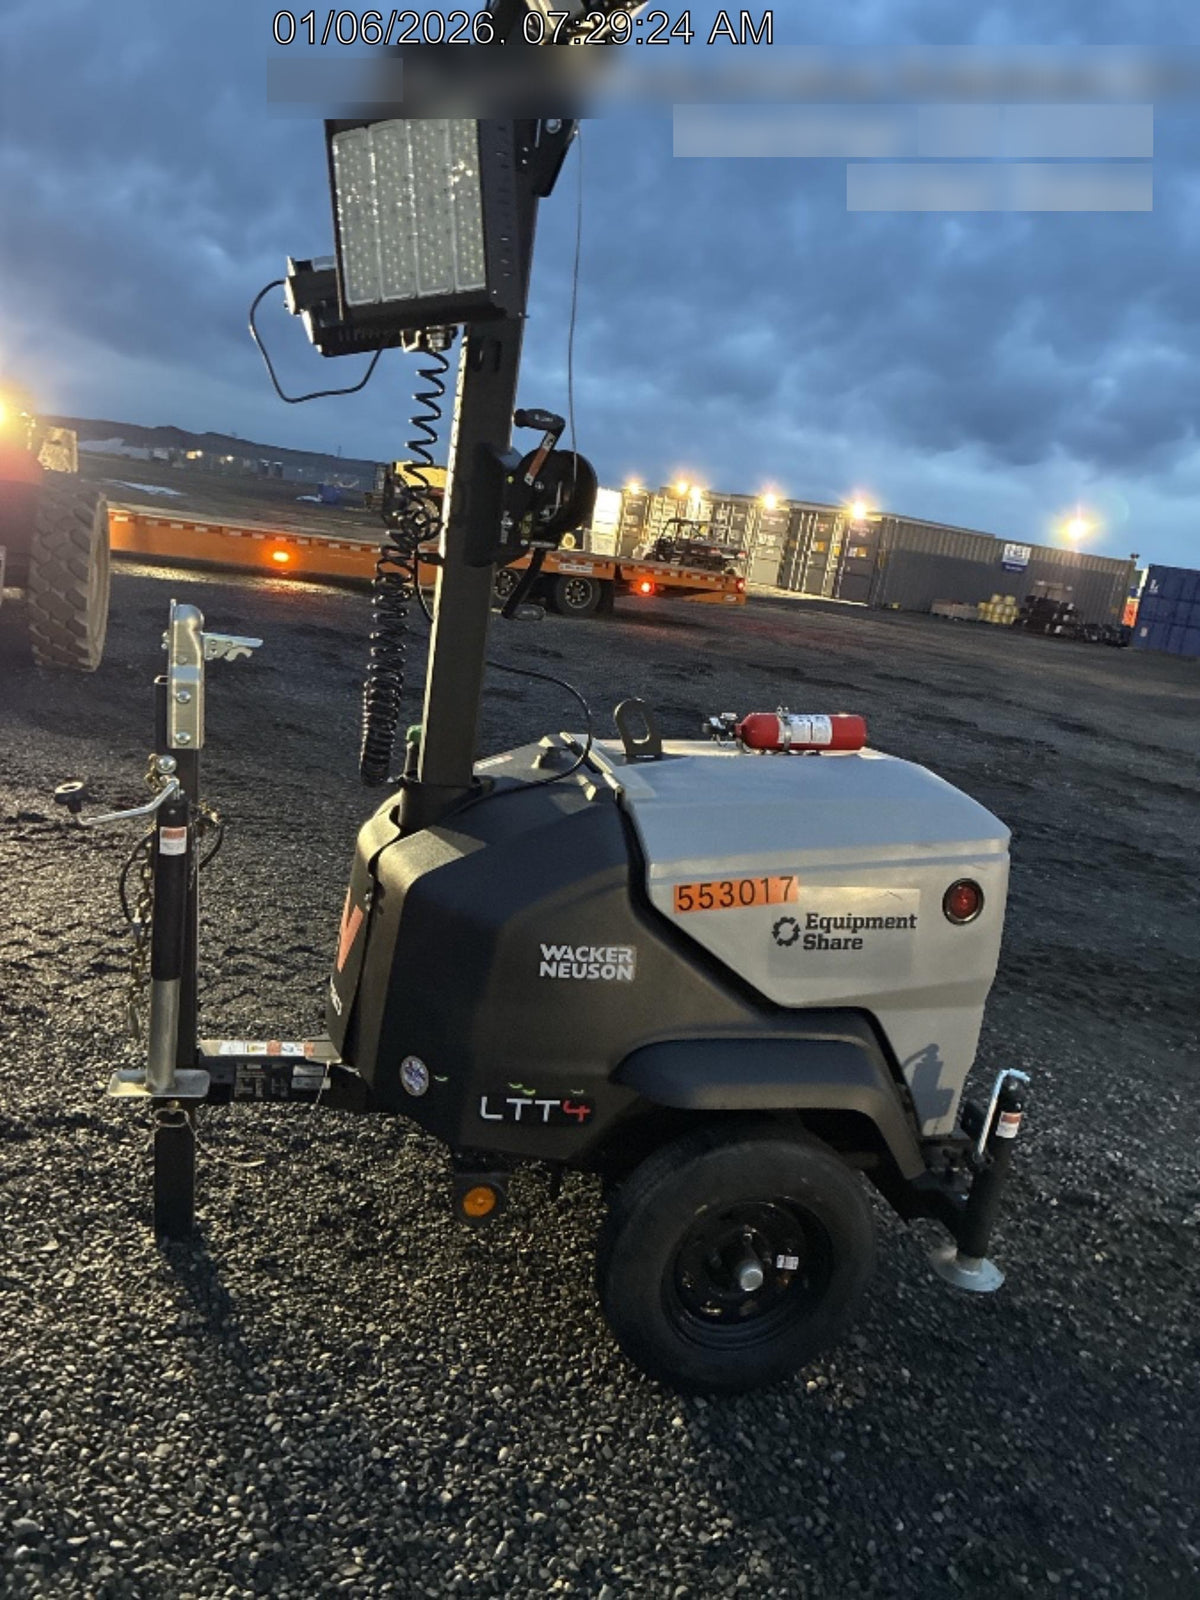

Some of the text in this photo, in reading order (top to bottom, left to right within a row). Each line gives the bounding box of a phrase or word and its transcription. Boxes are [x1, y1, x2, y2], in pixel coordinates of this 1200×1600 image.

[678, 875, 794, 911] 553017
[805, 912, 918, 934] Equipment
[803, 933, 864, 951] Share
[540, 943, 634, 964] WACKER
[540, 961, 634, 981] NEUSON
[480, 1096, 591, 1123] LTT4
